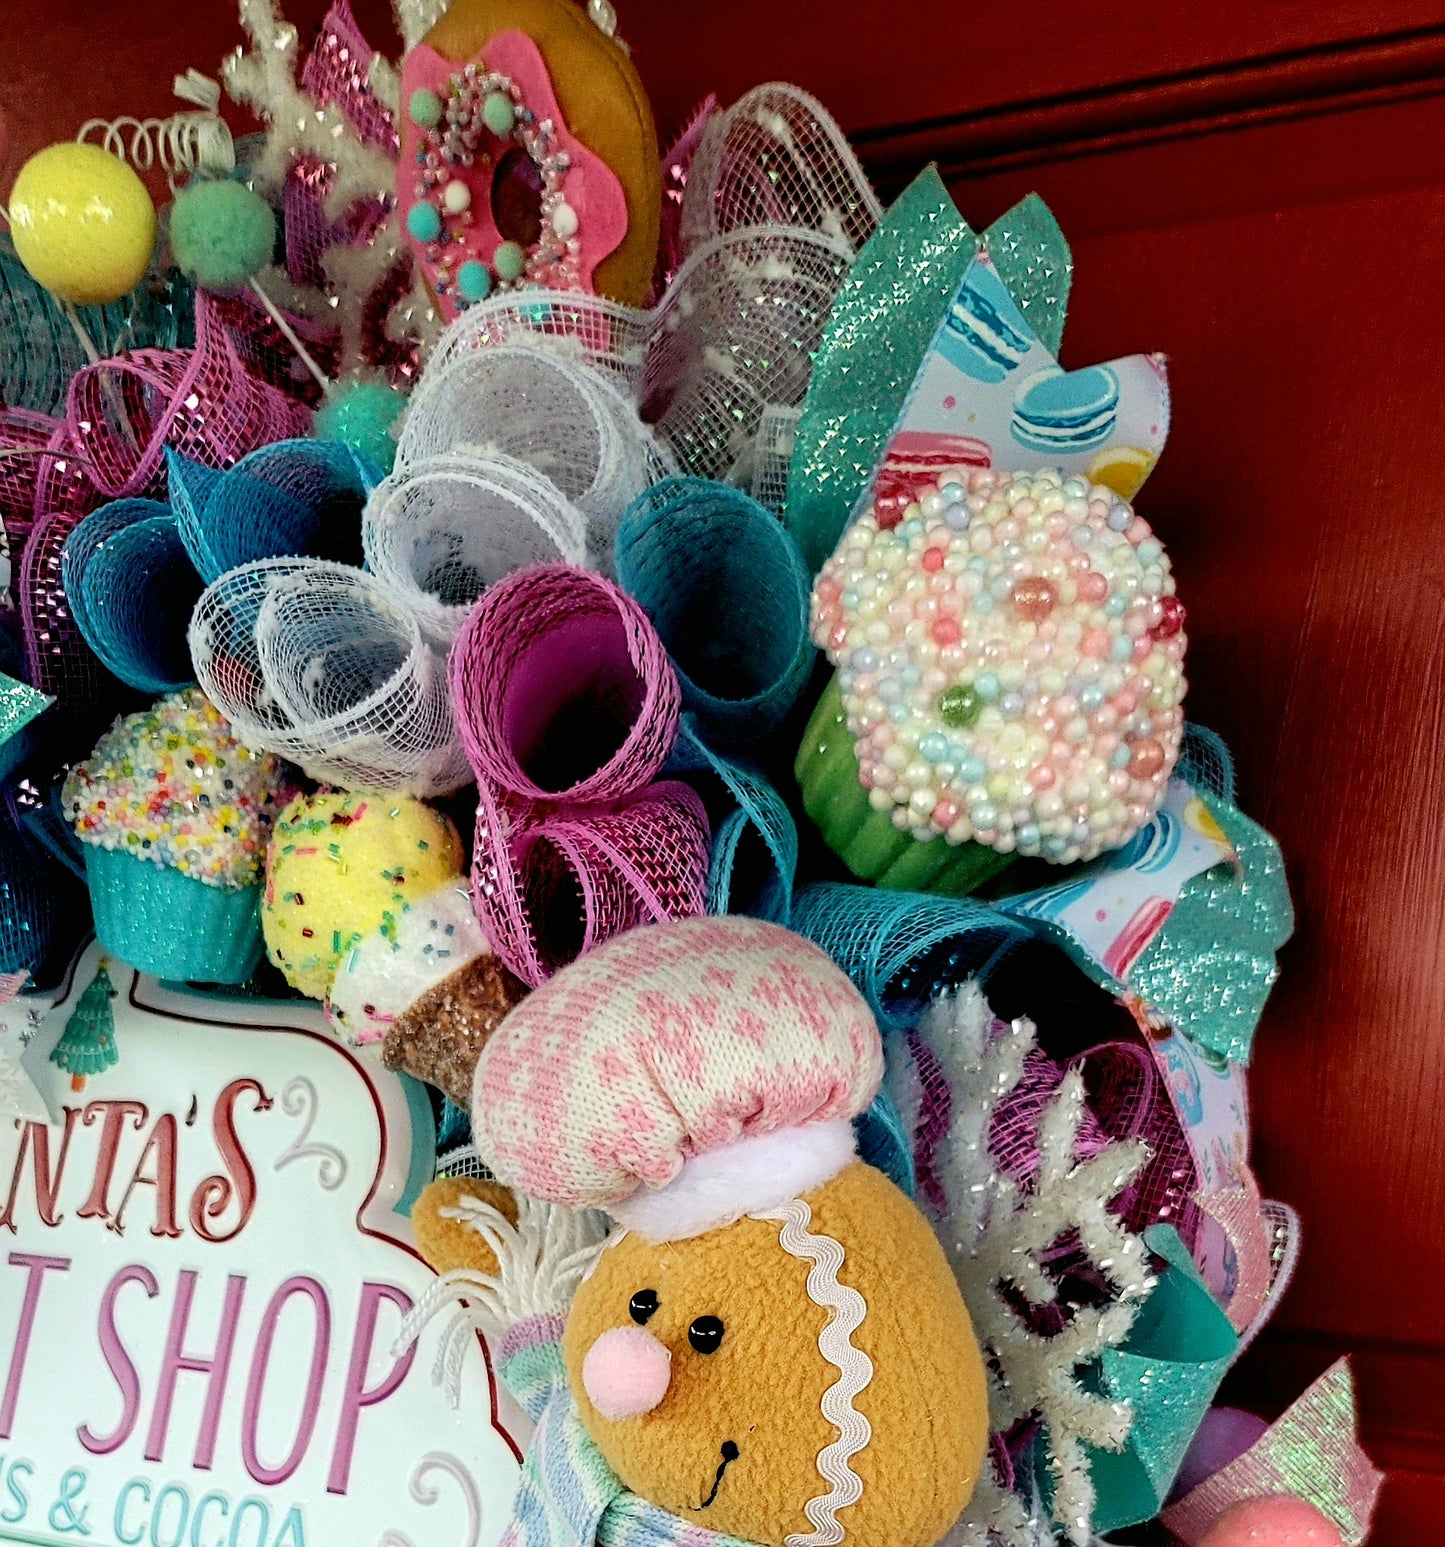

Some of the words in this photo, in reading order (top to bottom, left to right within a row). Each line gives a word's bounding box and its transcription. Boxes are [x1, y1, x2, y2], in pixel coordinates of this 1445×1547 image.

[76, 1264, 420, 1496] SHOP
[0, 1457, 34, 1524] S
[48, 1470, 92, 1536] &
